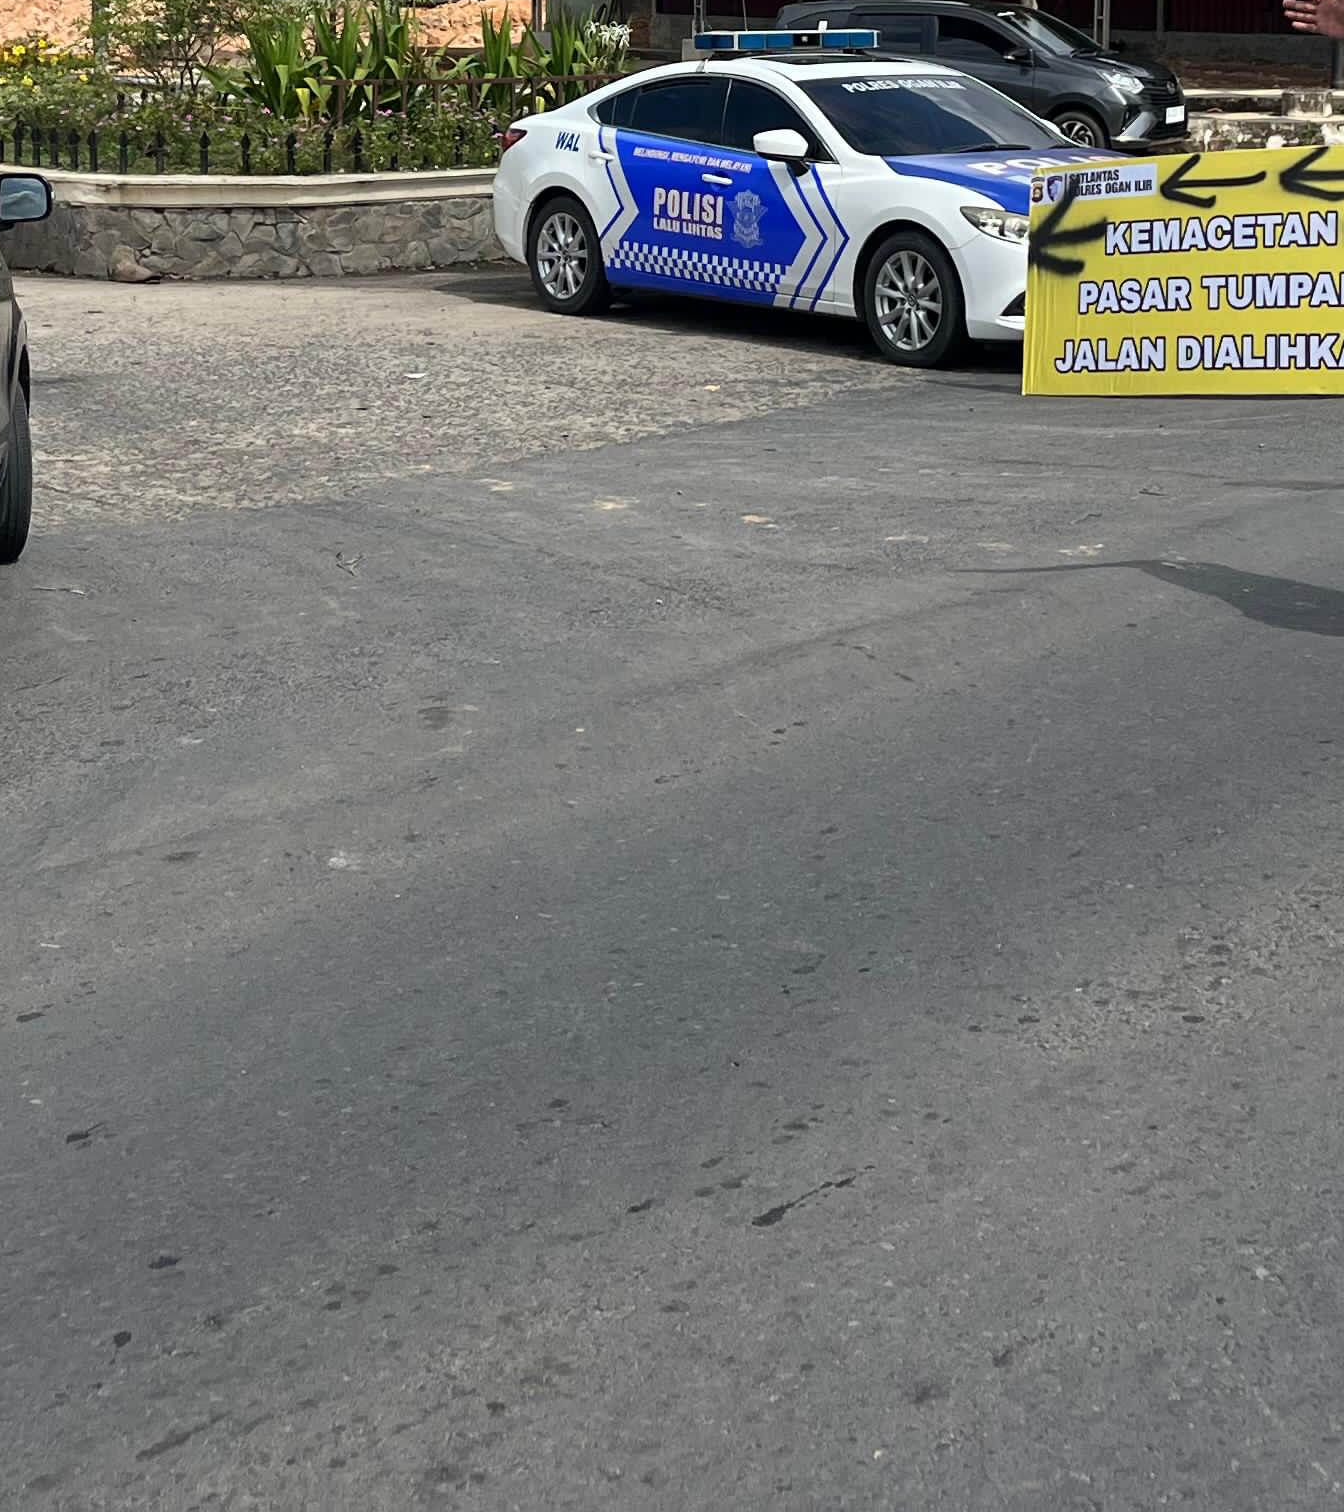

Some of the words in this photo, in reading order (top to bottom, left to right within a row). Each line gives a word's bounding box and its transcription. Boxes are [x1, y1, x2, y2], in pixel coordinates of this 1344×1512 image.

[554, 131, 581, 153] WAL
[1104, 180, 1132, 194] OGAN
[1134, 179, 1153, 192] ILIR
[653, 188, 724, 225] POLISI
[653, 217, 681, 233] LALU
[1105, 210, 1338, 256] KEMACETAN
[1078, 277, 1192, 314] PASAR
[1055, 337, 1166, 373] JALAN
